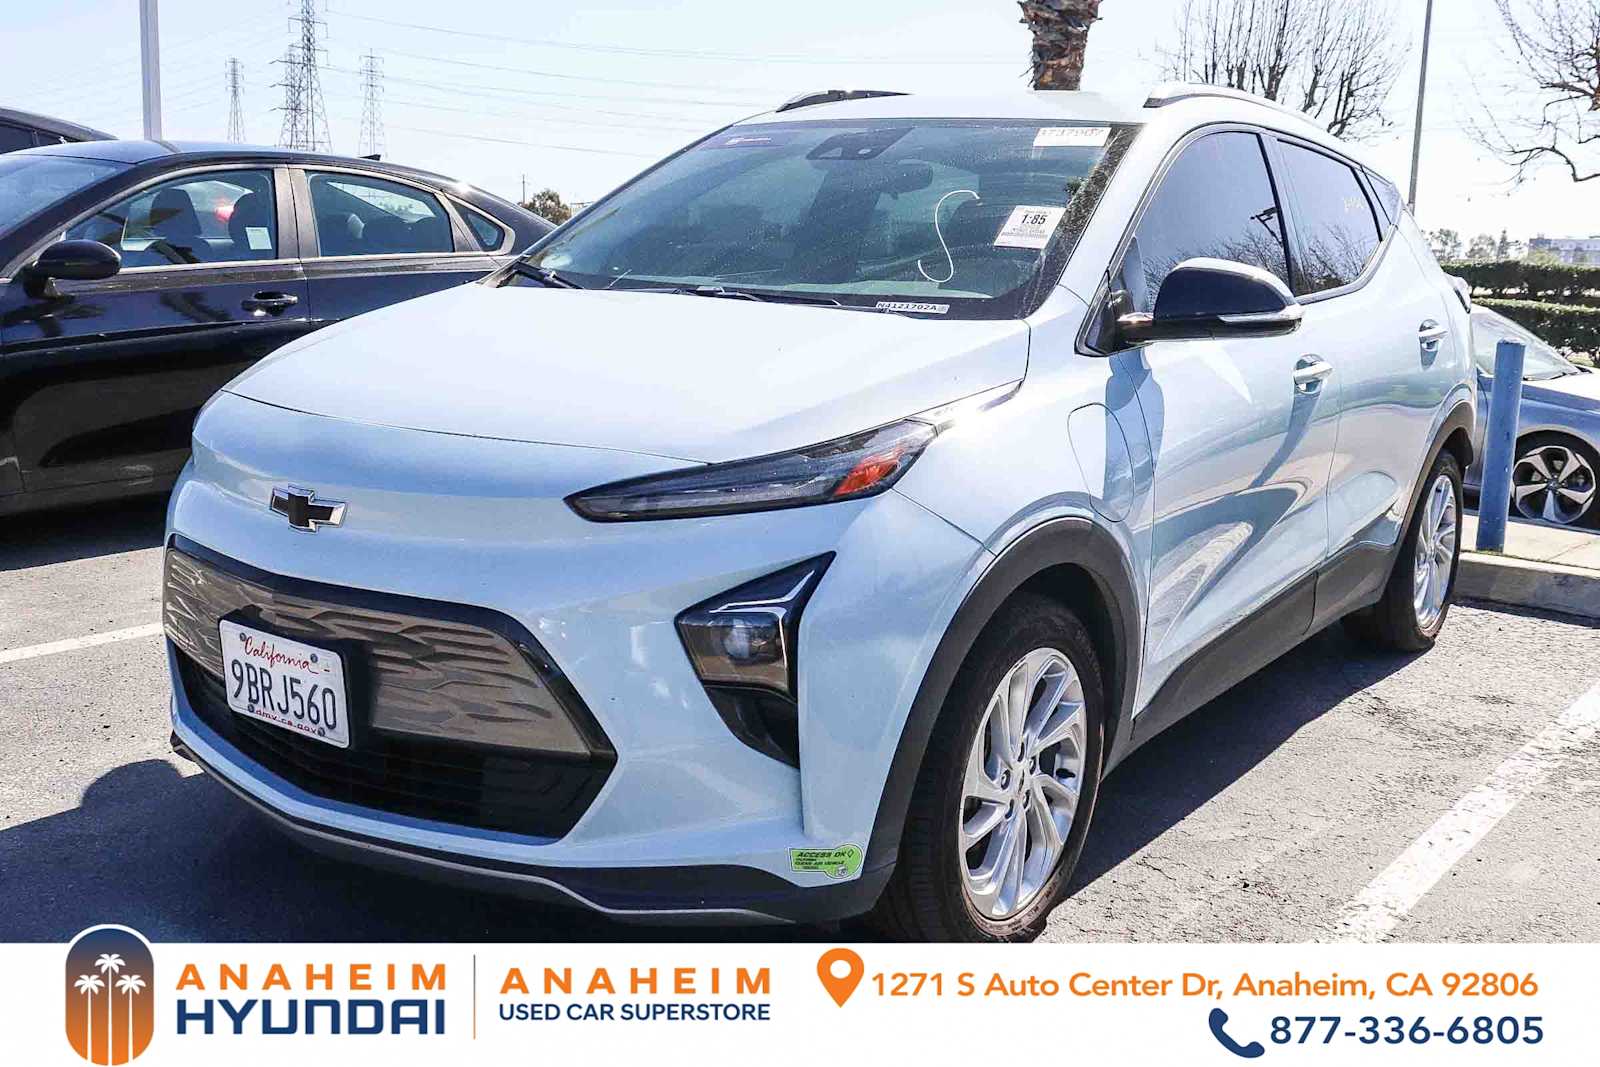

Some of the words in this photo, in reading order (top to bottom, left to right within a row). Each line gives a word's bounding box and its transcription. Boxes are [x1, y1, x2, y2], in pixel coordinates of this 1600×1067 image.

[1021, 213, 1048, 225] 1:85
[244, 635, 319, 675] California
[231, 659, 337, 730] 9BRJ560
[255, 709, 318, 735] dmv.ca.gov
